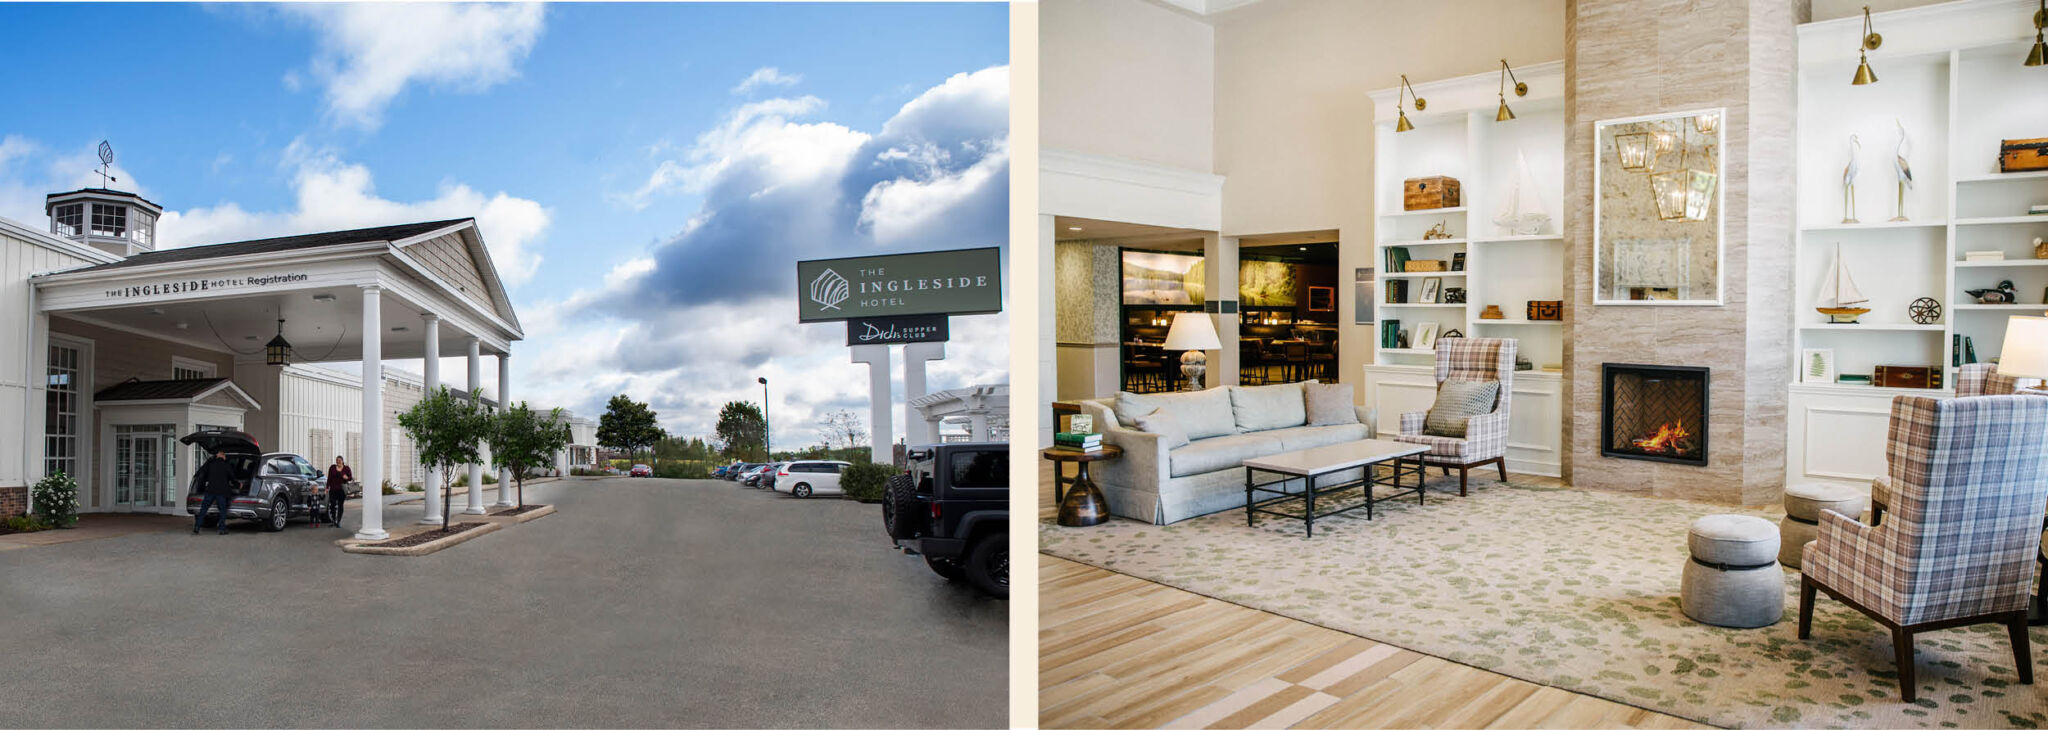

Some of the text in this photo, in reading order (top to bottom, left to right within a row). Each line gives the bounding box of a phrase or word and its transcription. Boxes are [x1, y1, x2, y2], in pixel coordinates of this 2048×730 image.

[859, 268, 885, 277] THE
[105, 272, 307, 298] THE INGLESIDE HOTEL Registration
[859, 276, 987, 293] INGLESIDE
[860, 298, 905, 307] HOTEL
